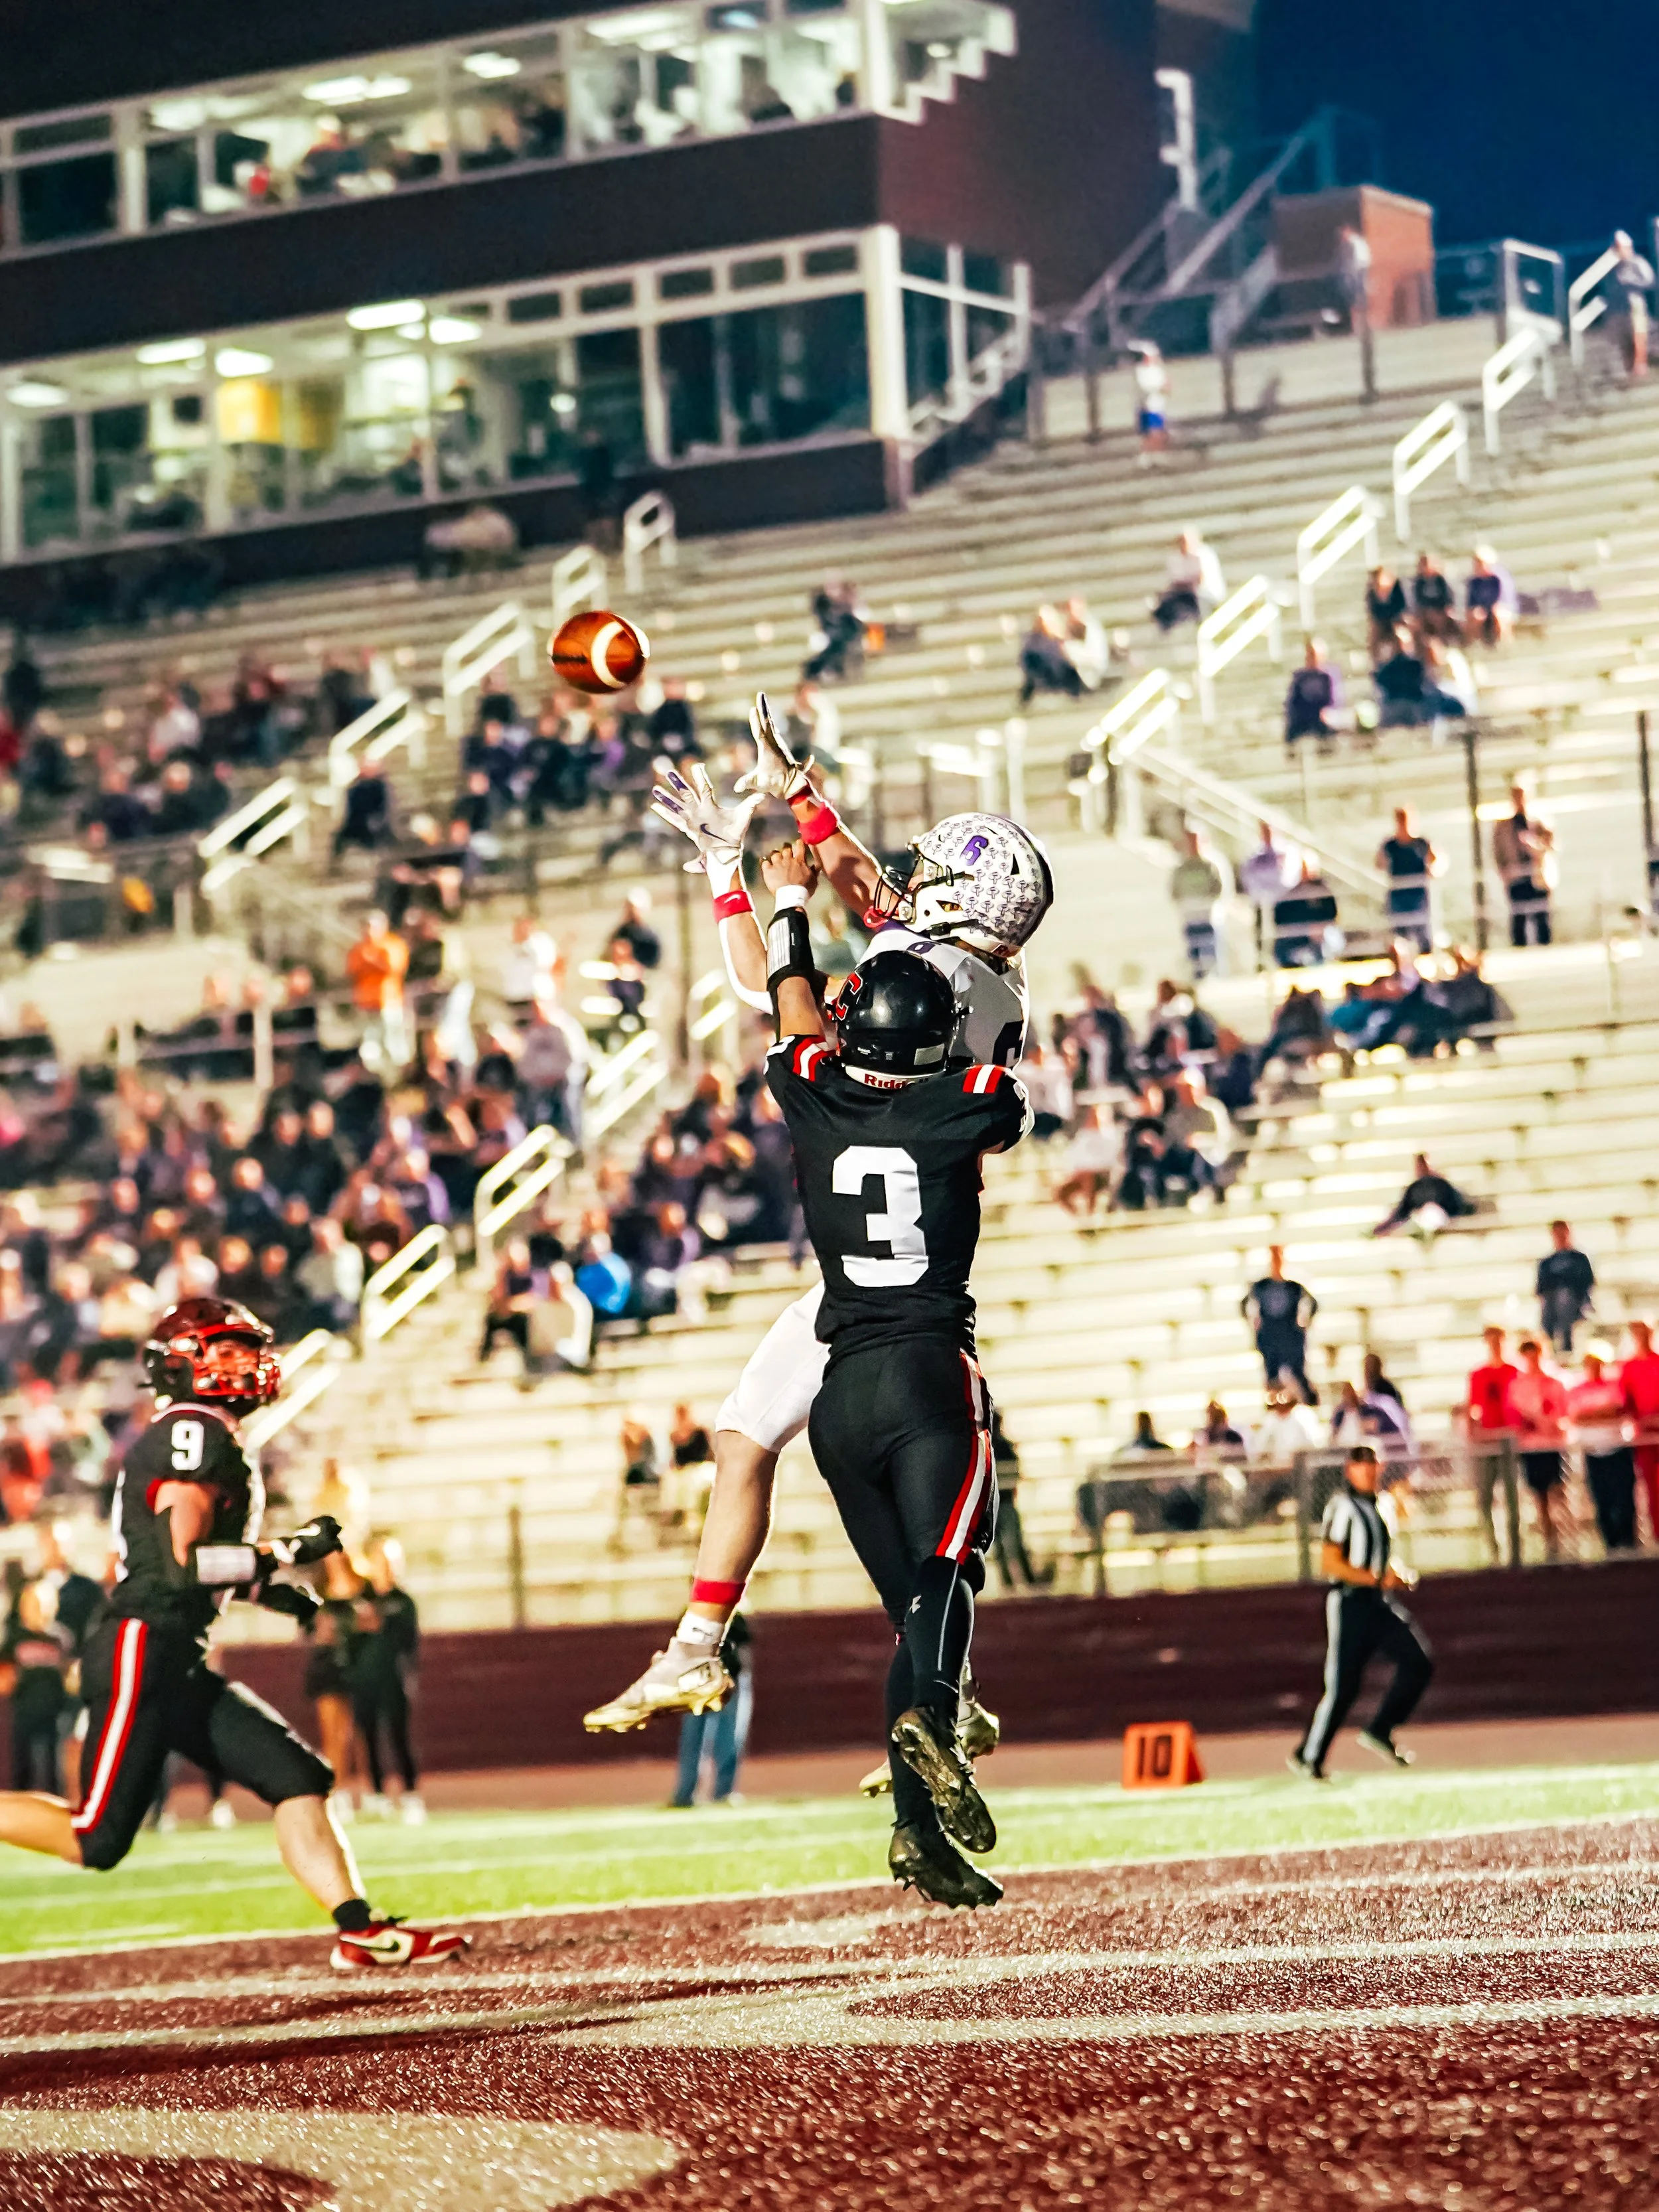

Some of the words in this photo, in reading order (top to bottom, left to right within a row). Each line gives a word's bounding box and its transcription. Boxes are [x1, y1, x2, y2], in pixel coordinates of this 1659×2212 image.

[959, 835, 989, 866] 6
[832, 1145, 929, 1288] 3
[171, 1420, 204, 1471] 9
[1137, 1735, 1173, 1780] 10
